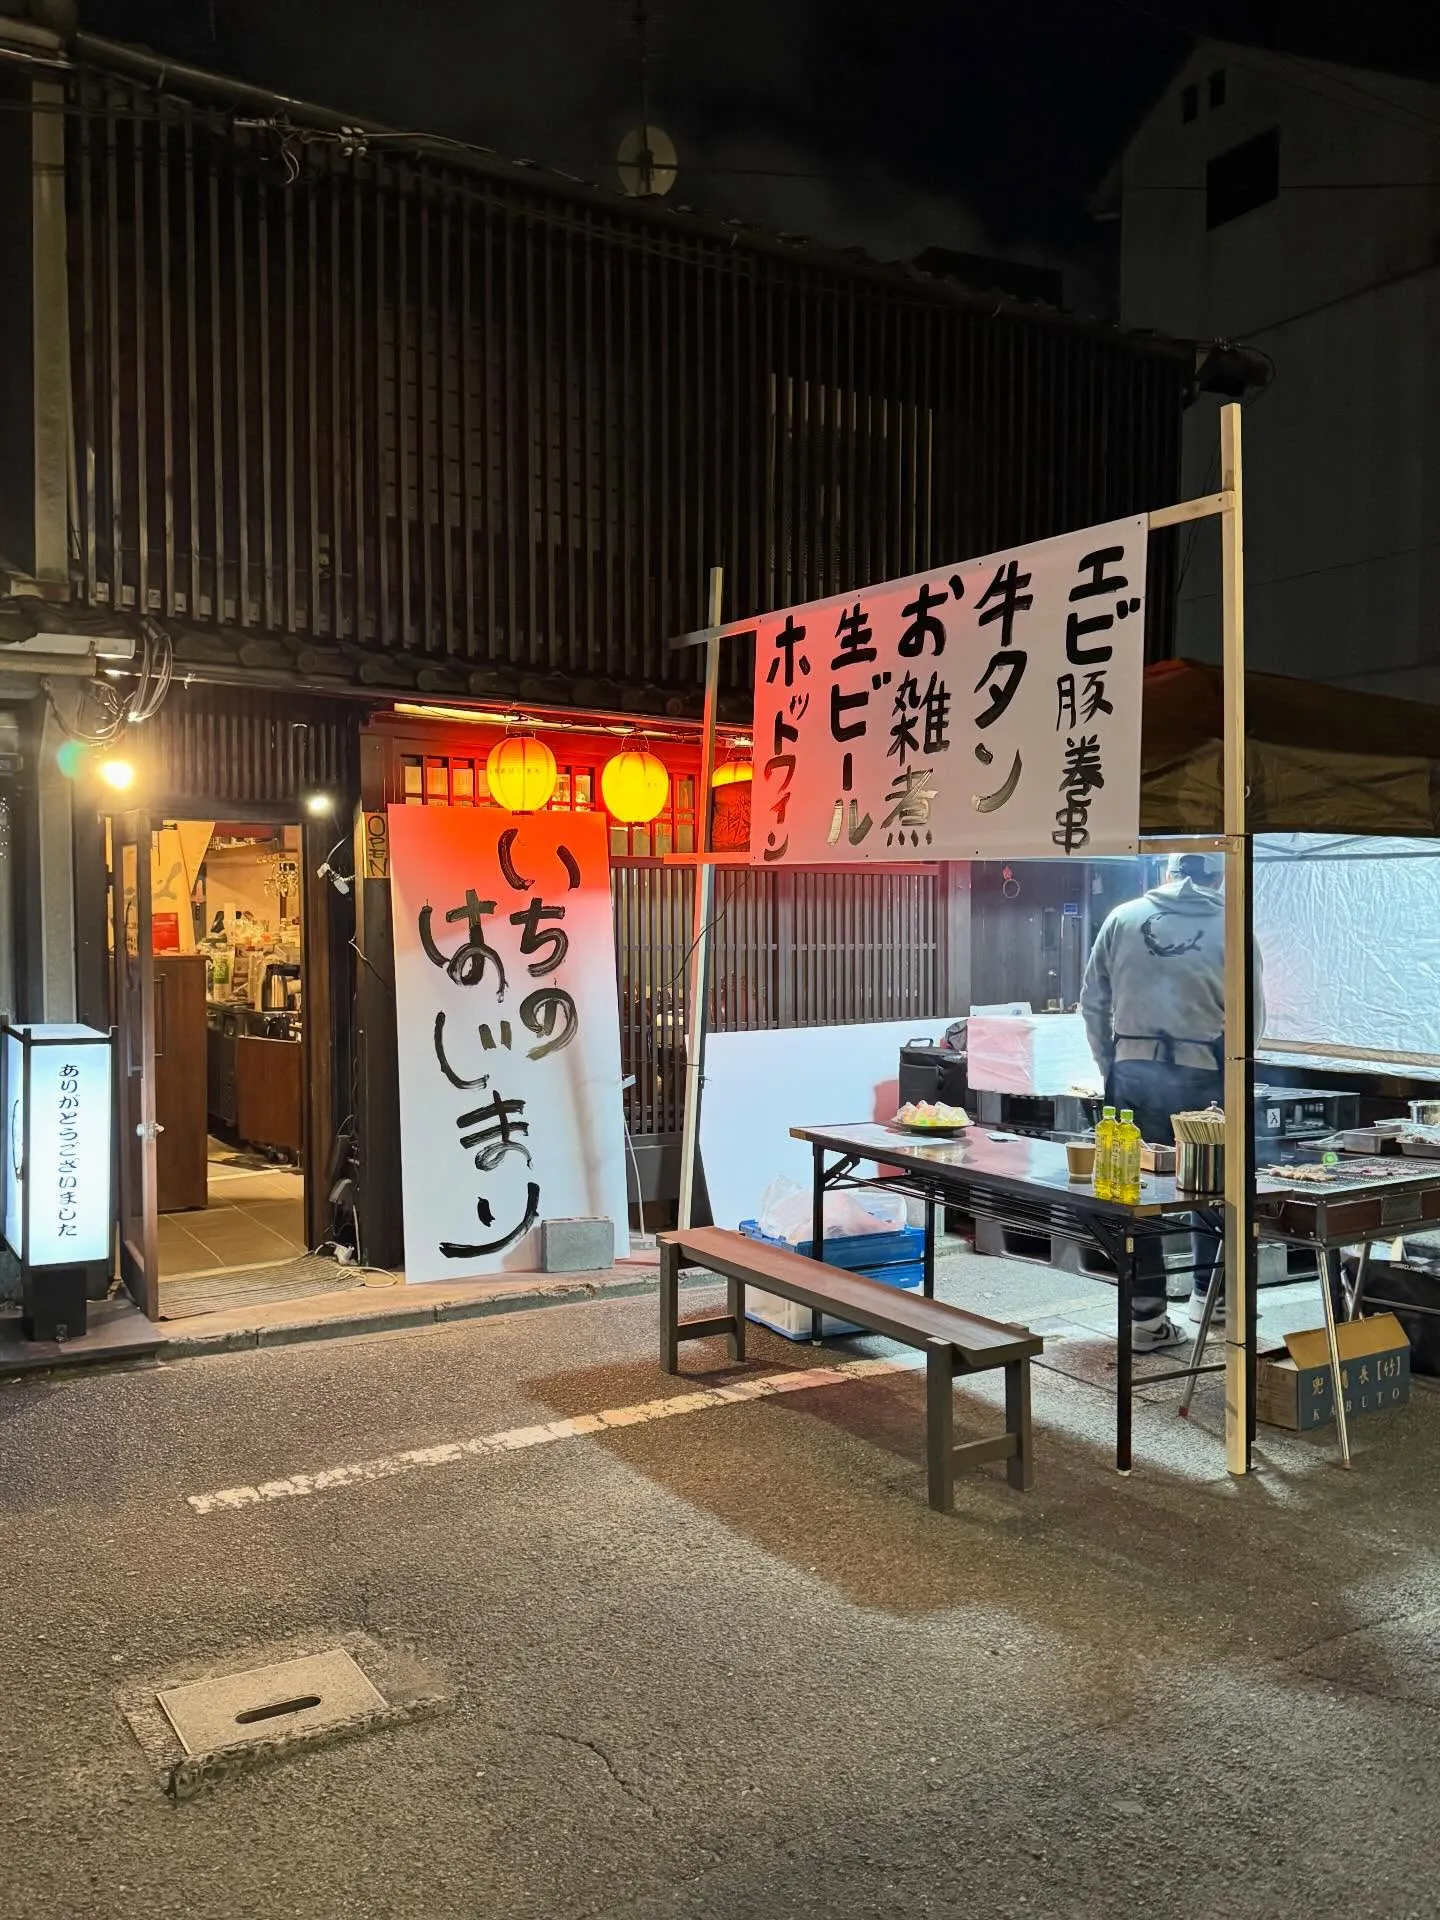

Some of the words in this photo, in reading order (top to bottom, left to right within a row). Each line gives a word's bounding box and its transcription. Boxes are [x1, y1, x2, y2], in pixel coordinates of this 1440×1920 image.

[764, 615, 810, 862] ホットワイン
[827, 603, 891, 846] 生ビール
[880, 575, 965, 847] お雑煮
[972, 560, 1034, 813] 牛タン
[367, 815, 388, 876] OPEN
[497, 828, 581, 1061] いちの
[57, 1063, 80, 1237] ありがとうございました
[418, 888, 541, 1258] はじまり
